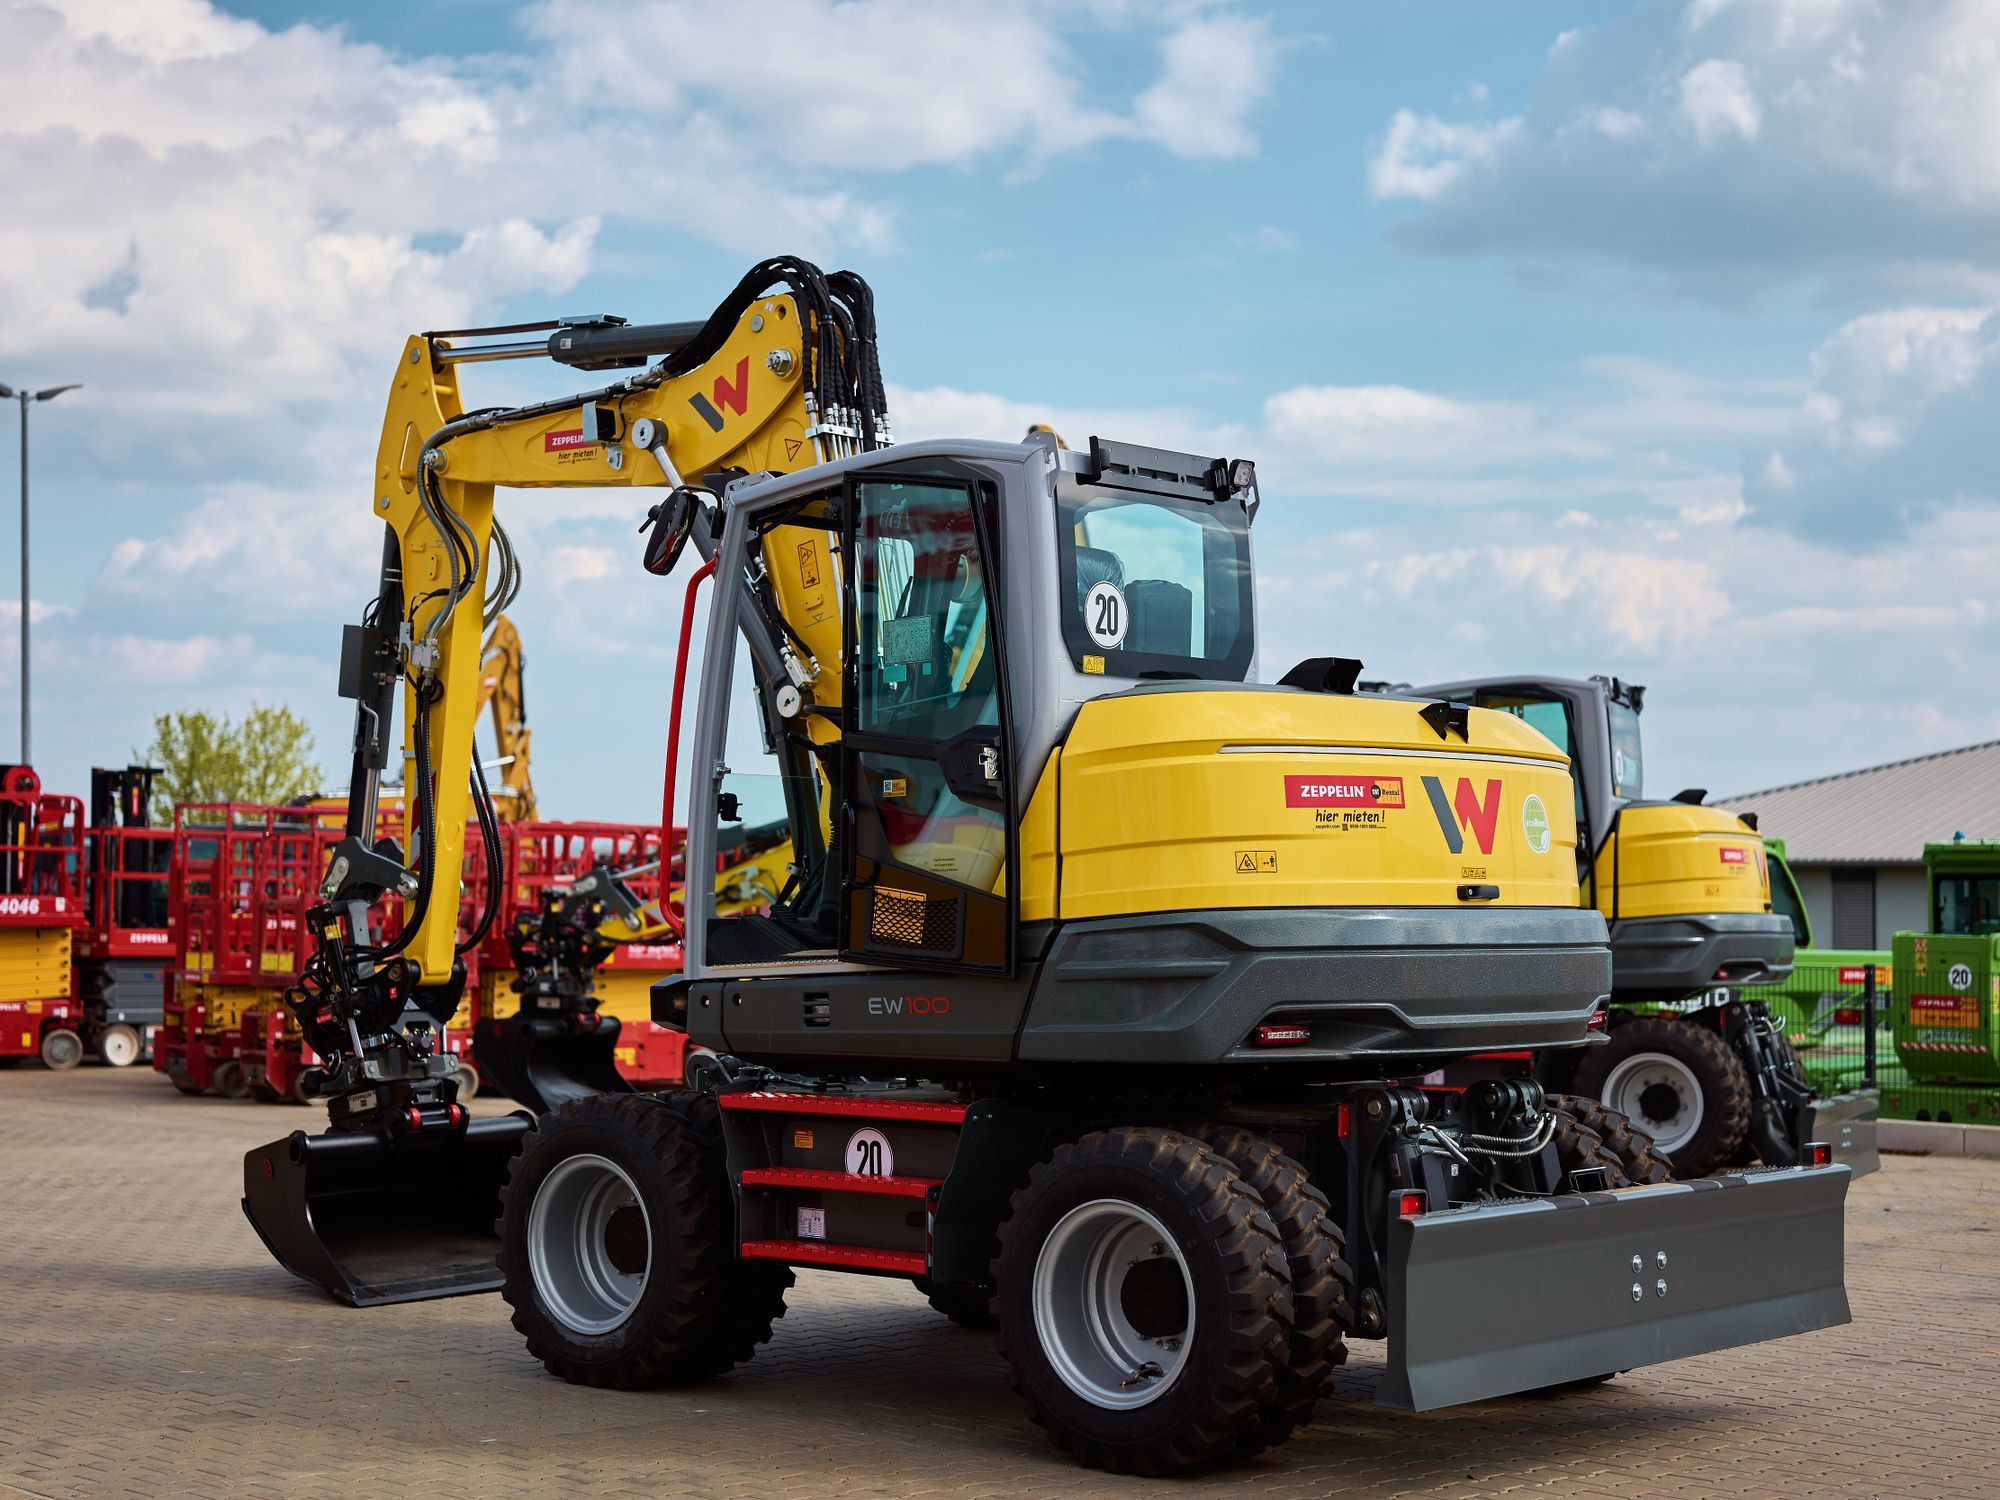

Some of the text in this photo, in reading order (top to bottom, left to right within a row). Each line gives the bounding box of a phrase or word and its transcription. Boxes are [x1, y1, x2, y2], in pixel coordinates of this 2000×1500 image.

[1095, 593, 1119, 636] 20
[1300, 785, 1365, 798] ZEPPELIN
[1381, 788, 1400, 796] Rental
[1315, 809, 1339, 823] hier
[0, 898, 40, 915] 4046
[1951, 968, 1969, 985] 20
[868, 996, 950, 1015] EW100
[856, 1139, 882, 1176] 20
